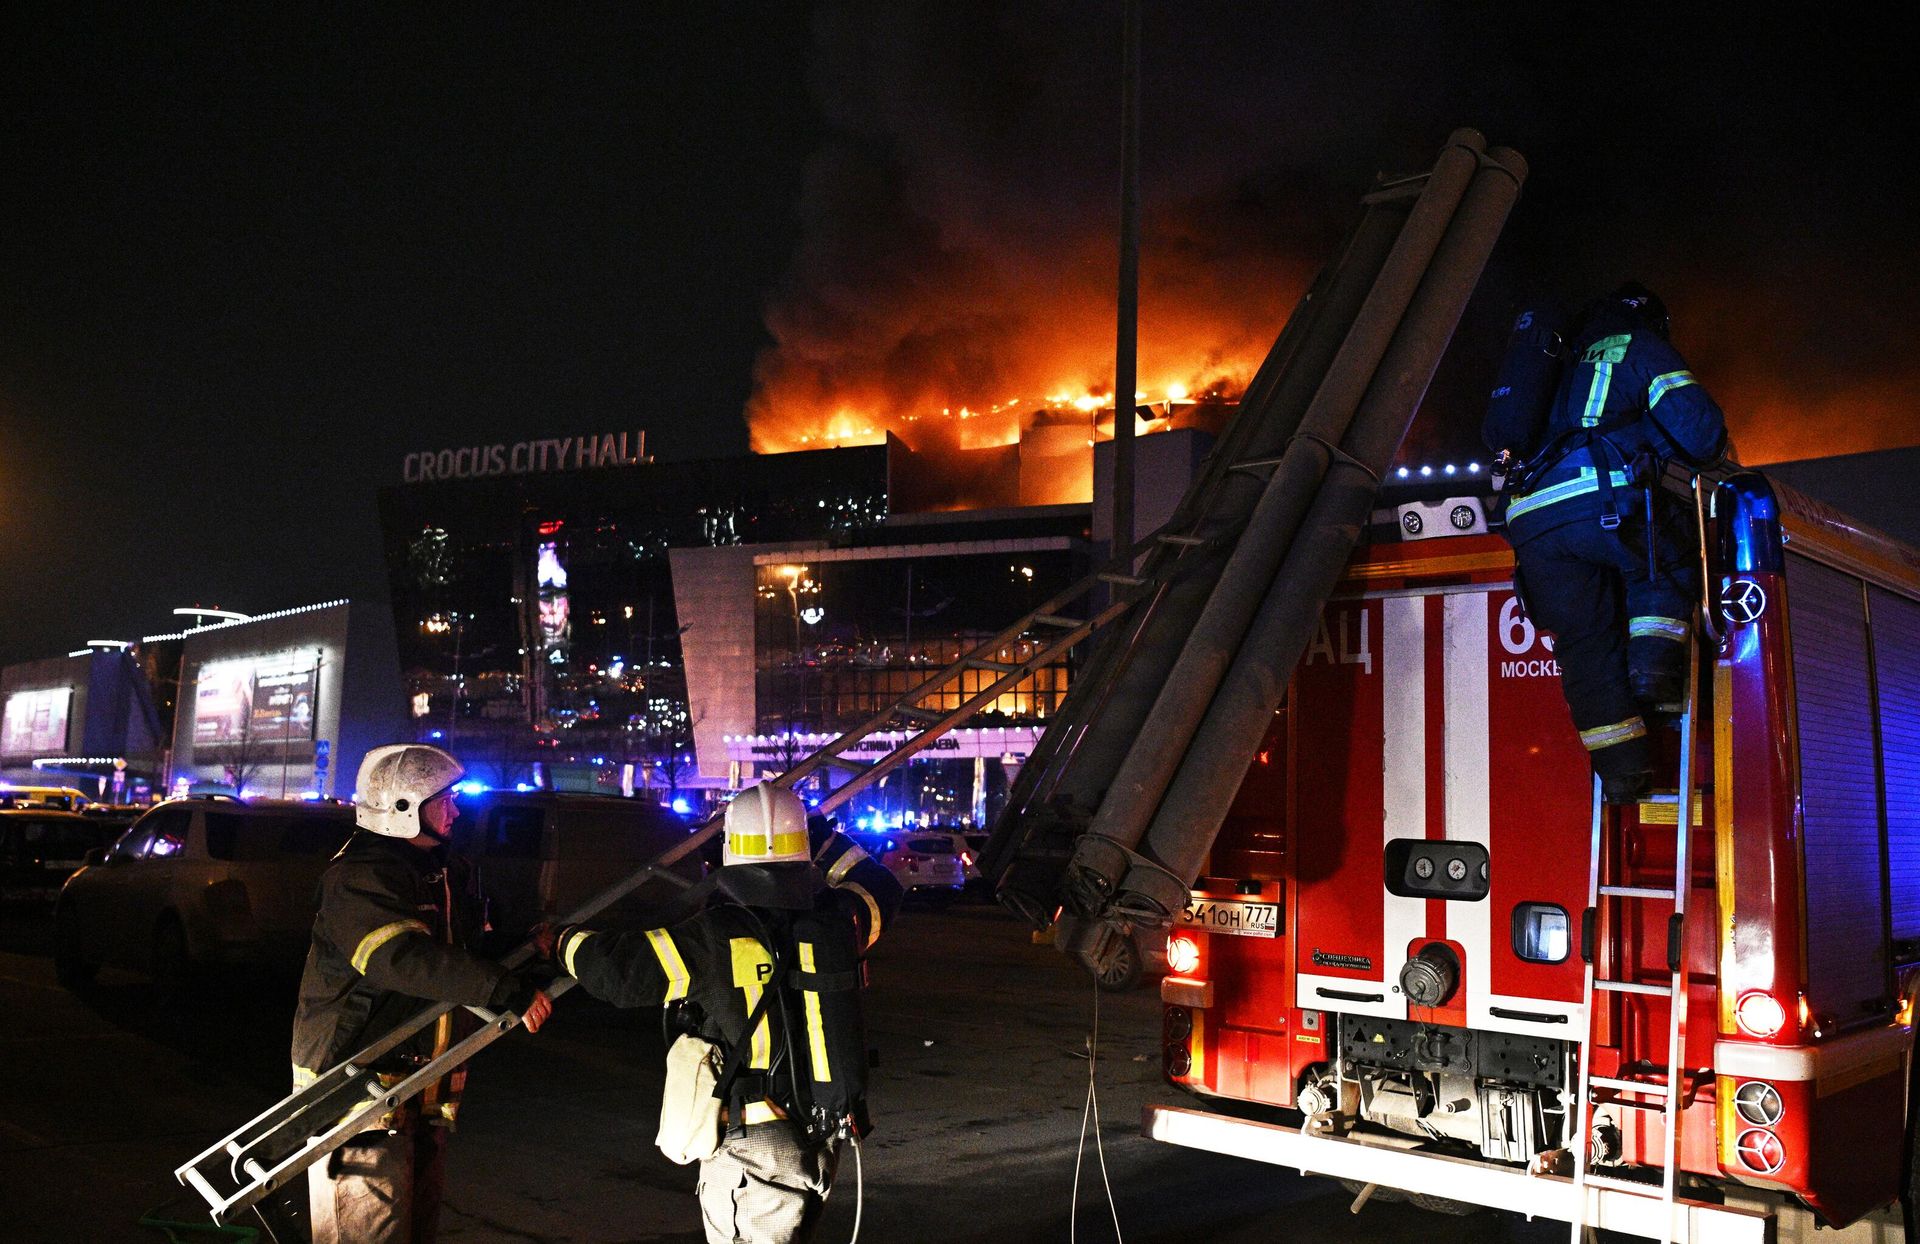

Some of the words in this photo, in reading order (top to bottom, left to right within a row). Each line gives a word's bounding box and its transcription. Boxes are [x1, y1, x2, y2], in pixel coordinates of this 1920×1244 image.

[403, 443, 507, 483] CROCUS
[511, 438, 573, 473] CITY
[575, 430, 655, 469] HALL
[1183, 904, 1240, 926] 541ОН
[1244, 905, 1273, 924] 777
[1250, 922, 1265, 930] RUS
